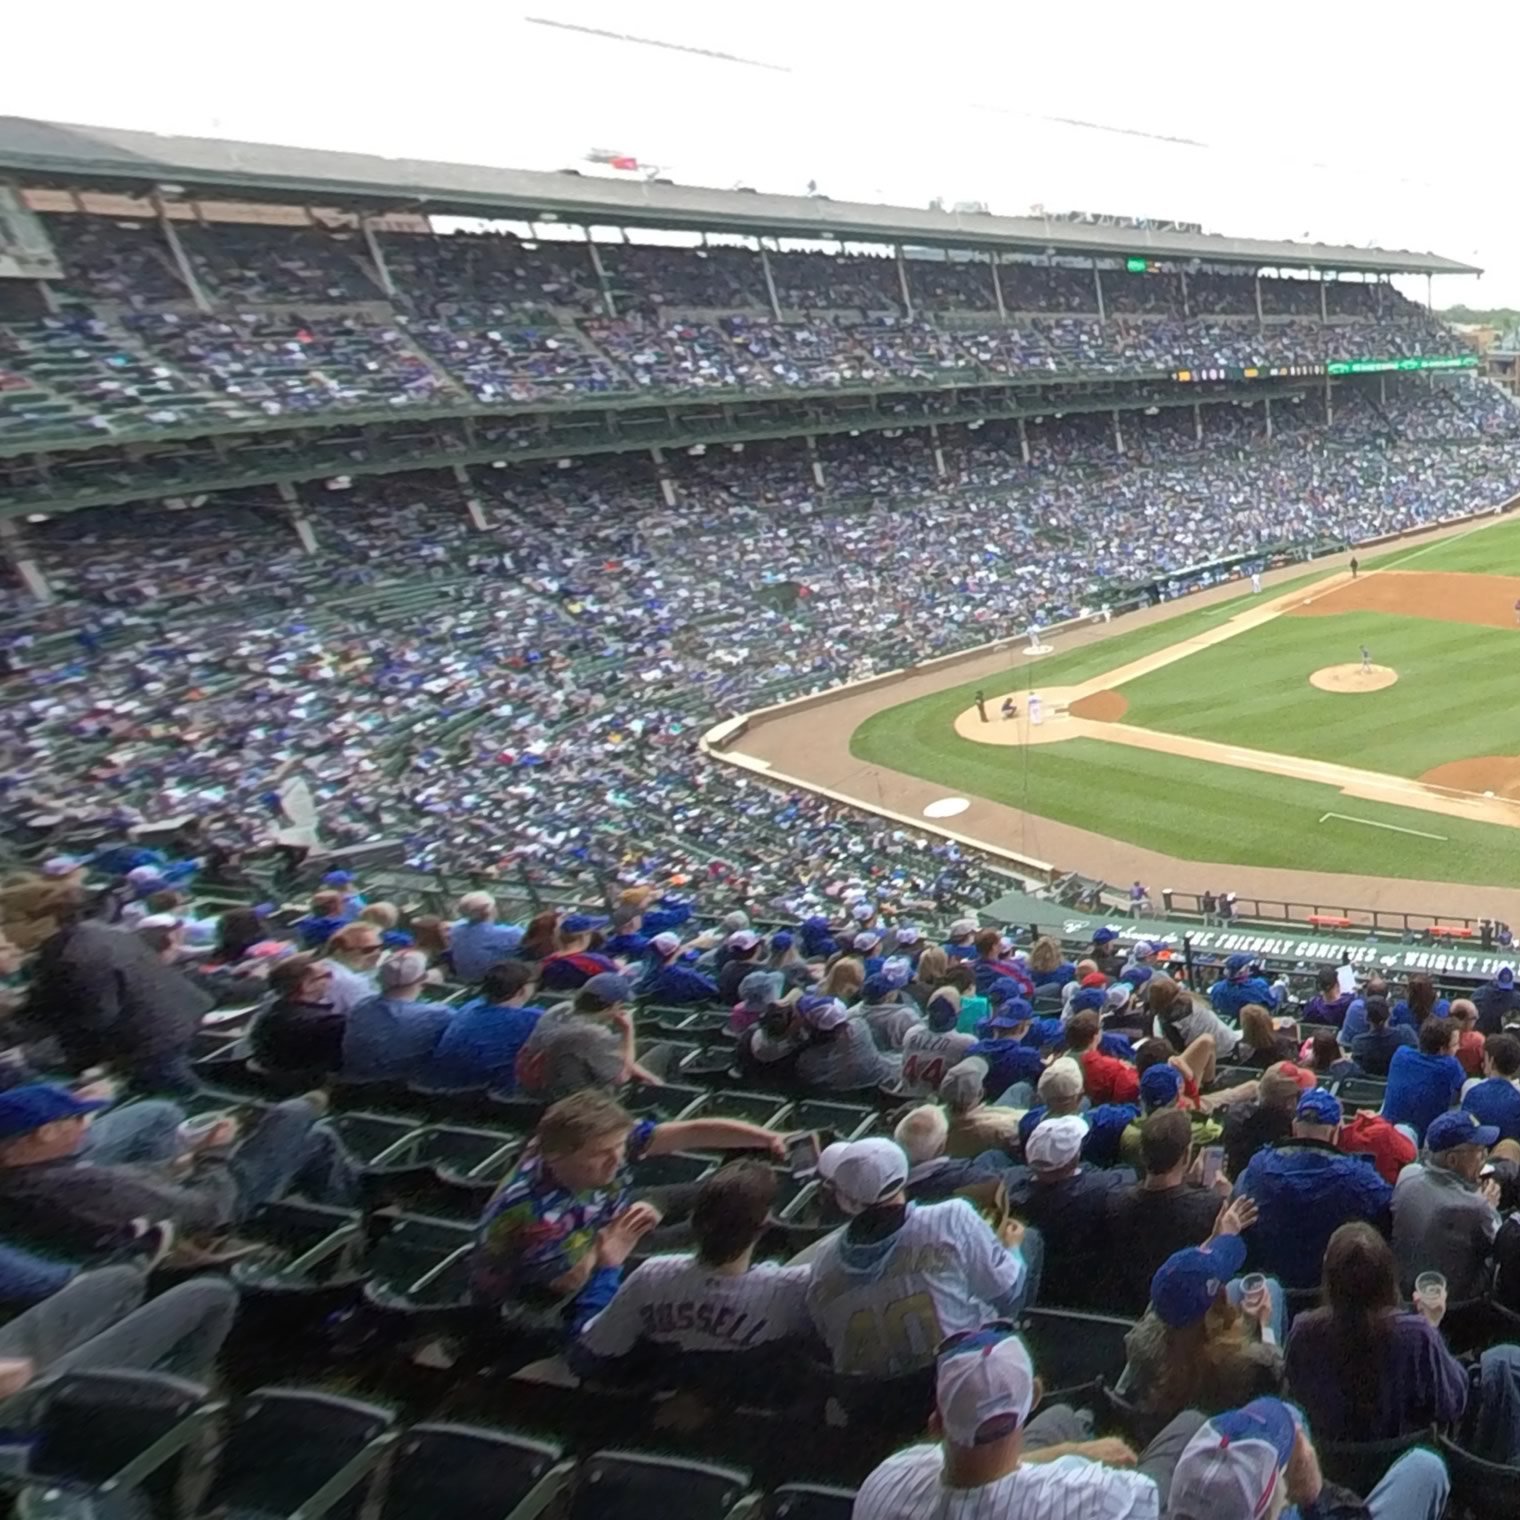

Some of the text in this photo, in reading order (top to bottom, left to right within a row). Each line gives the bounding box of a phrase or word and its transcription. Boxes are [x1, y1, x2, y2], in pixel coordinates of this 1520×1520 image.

[1215, 933, 1294, 955] FRIENDLY
[1294, 940, 1378, 962] CONFINES
[1404, 951, 1478, 972] WRIGLEY
